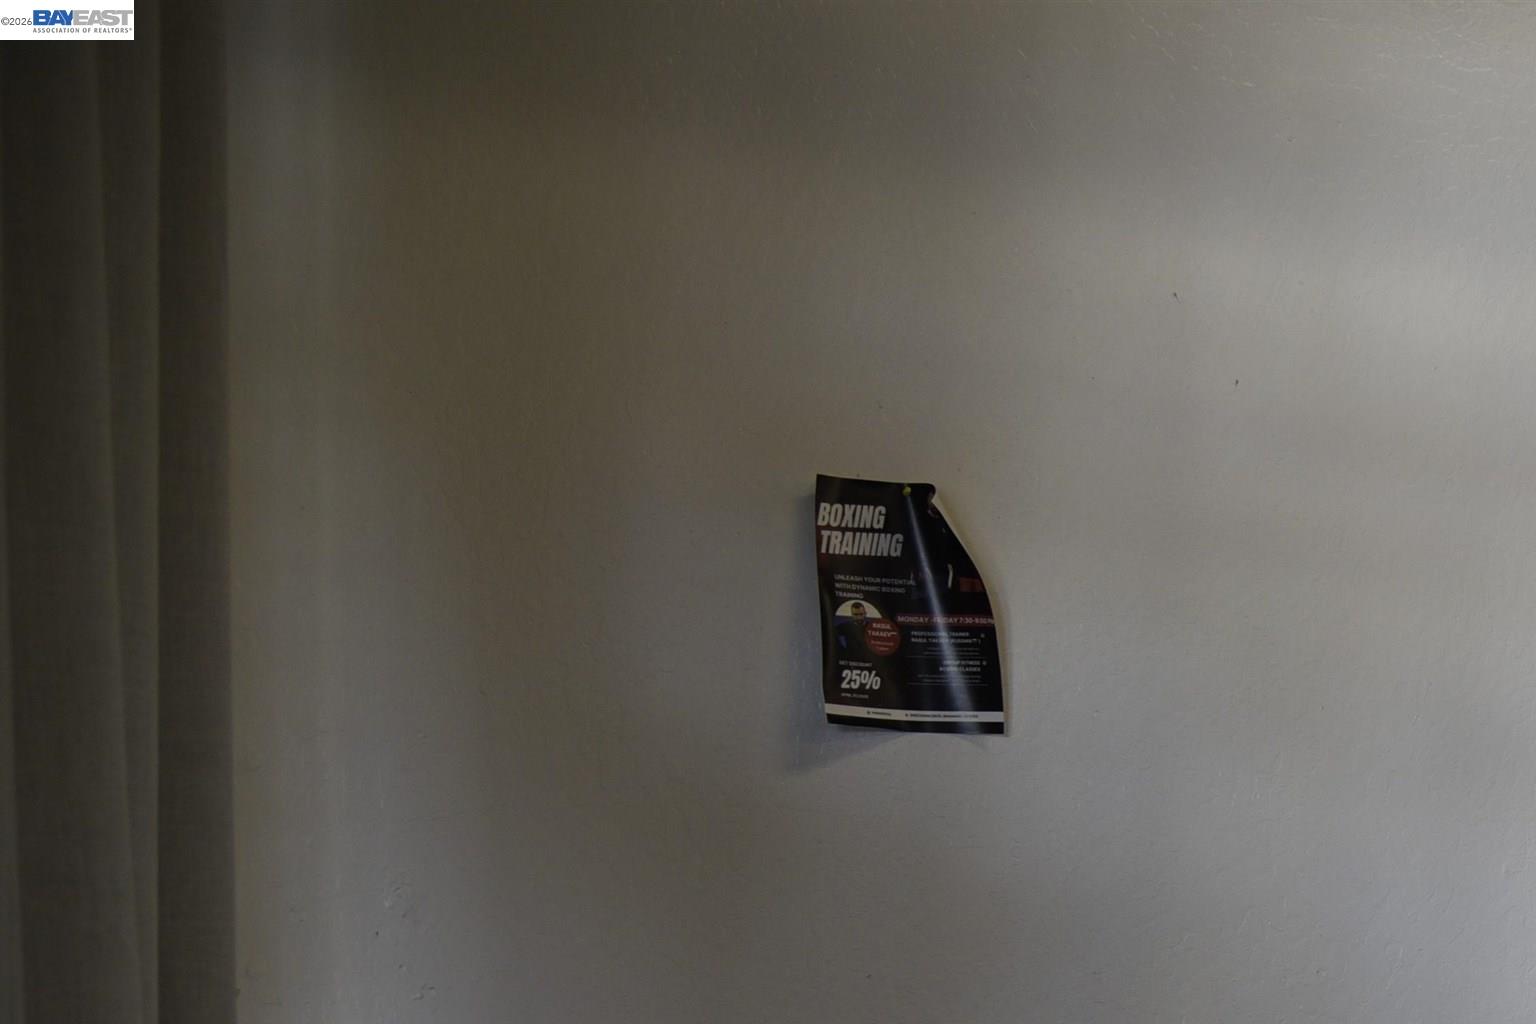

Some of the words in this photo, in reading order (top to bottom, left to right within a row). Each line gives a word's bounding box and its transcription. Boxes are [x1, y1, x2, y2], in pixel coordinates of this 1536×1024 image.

[817, 502, 887, 529] BOXING
[821, 530, 904, 558] TRAINING
[898, 615, 929, 624] MONDAY
[840, 669, 881, 690] 25%
